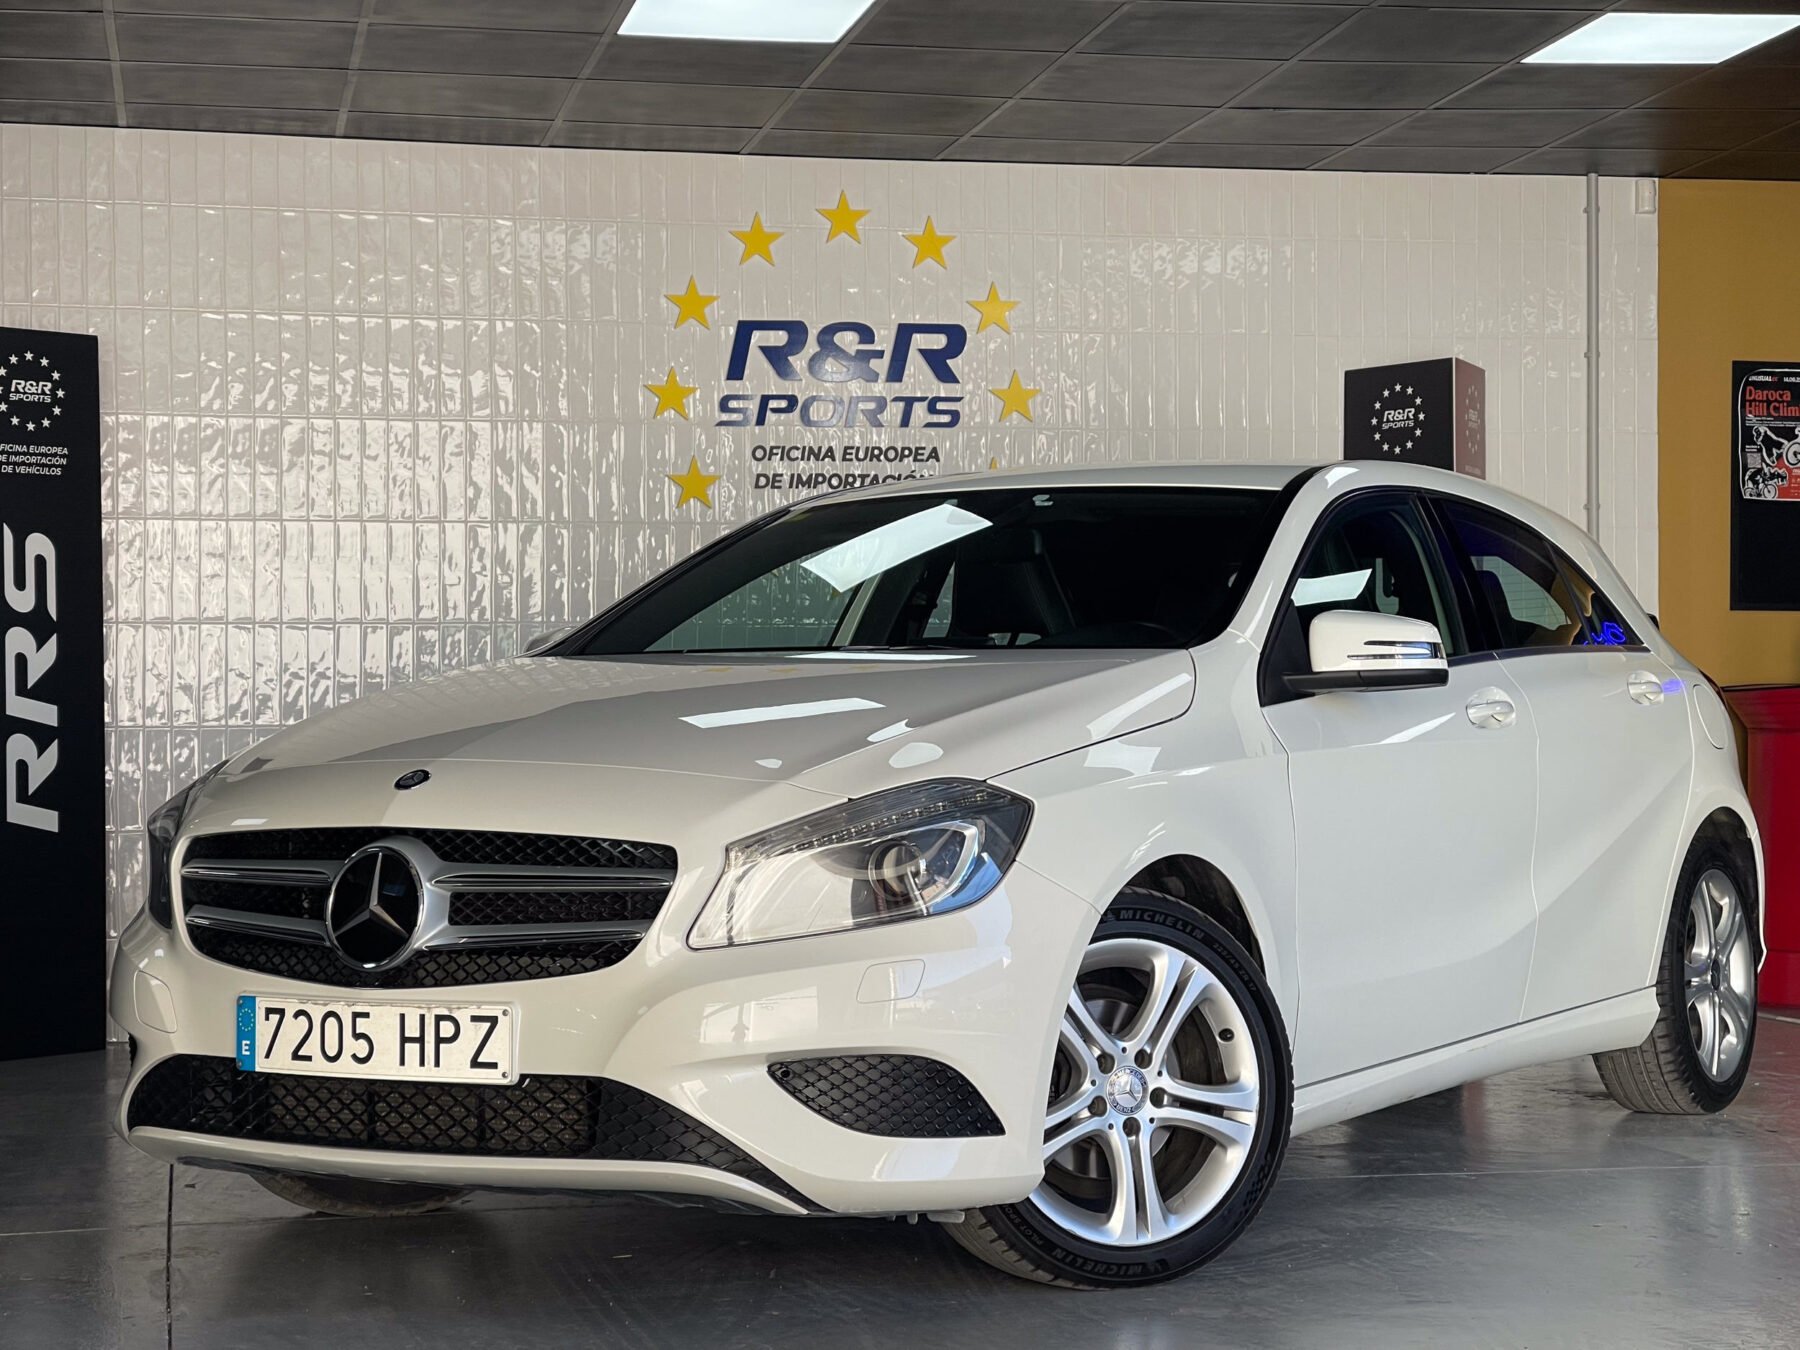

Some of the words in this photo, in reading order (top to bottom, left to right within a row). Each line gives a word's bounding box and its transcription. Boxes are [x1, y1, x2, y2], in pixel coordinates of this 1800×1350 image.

[726, 320, 967, 383] R&R
[11, 379, 52, 394] R&R
[1746, 386, 1791, 401] Daroca
[9, 393, 51, 403] SPORTS
[715, 394, 964, 428] SPORTS
[1383, 408, 1415, 422] R&R
[1746, 402, 1767, 416] Hill
[1770, 402, 1800, 416] Clim
[1381, 420, 1415, 430] SPORTS
[29, 445, 69, 455] EUROPEA
[751, 445, 836, 462] OFICINA
[842, 446, 941, 463] EUROPEA
[9, 455, 67, 465] IMPORTACIÓN
[1, 465, 14, 473] DE
[15, 465, 62, 475] VEHÍCULOS
[754, 473, 783, 489] DE
[3, 522, 59, 833] RRS
[1120, 909, 1205, 940] MICHELIN
[264, 1007, 374, 1064] 7205
[399, 1012, 499, 1069] HPZ
[241, 1040, 250, 1055] E
[1052, 1248, 1143, 1275] MICHELIN
